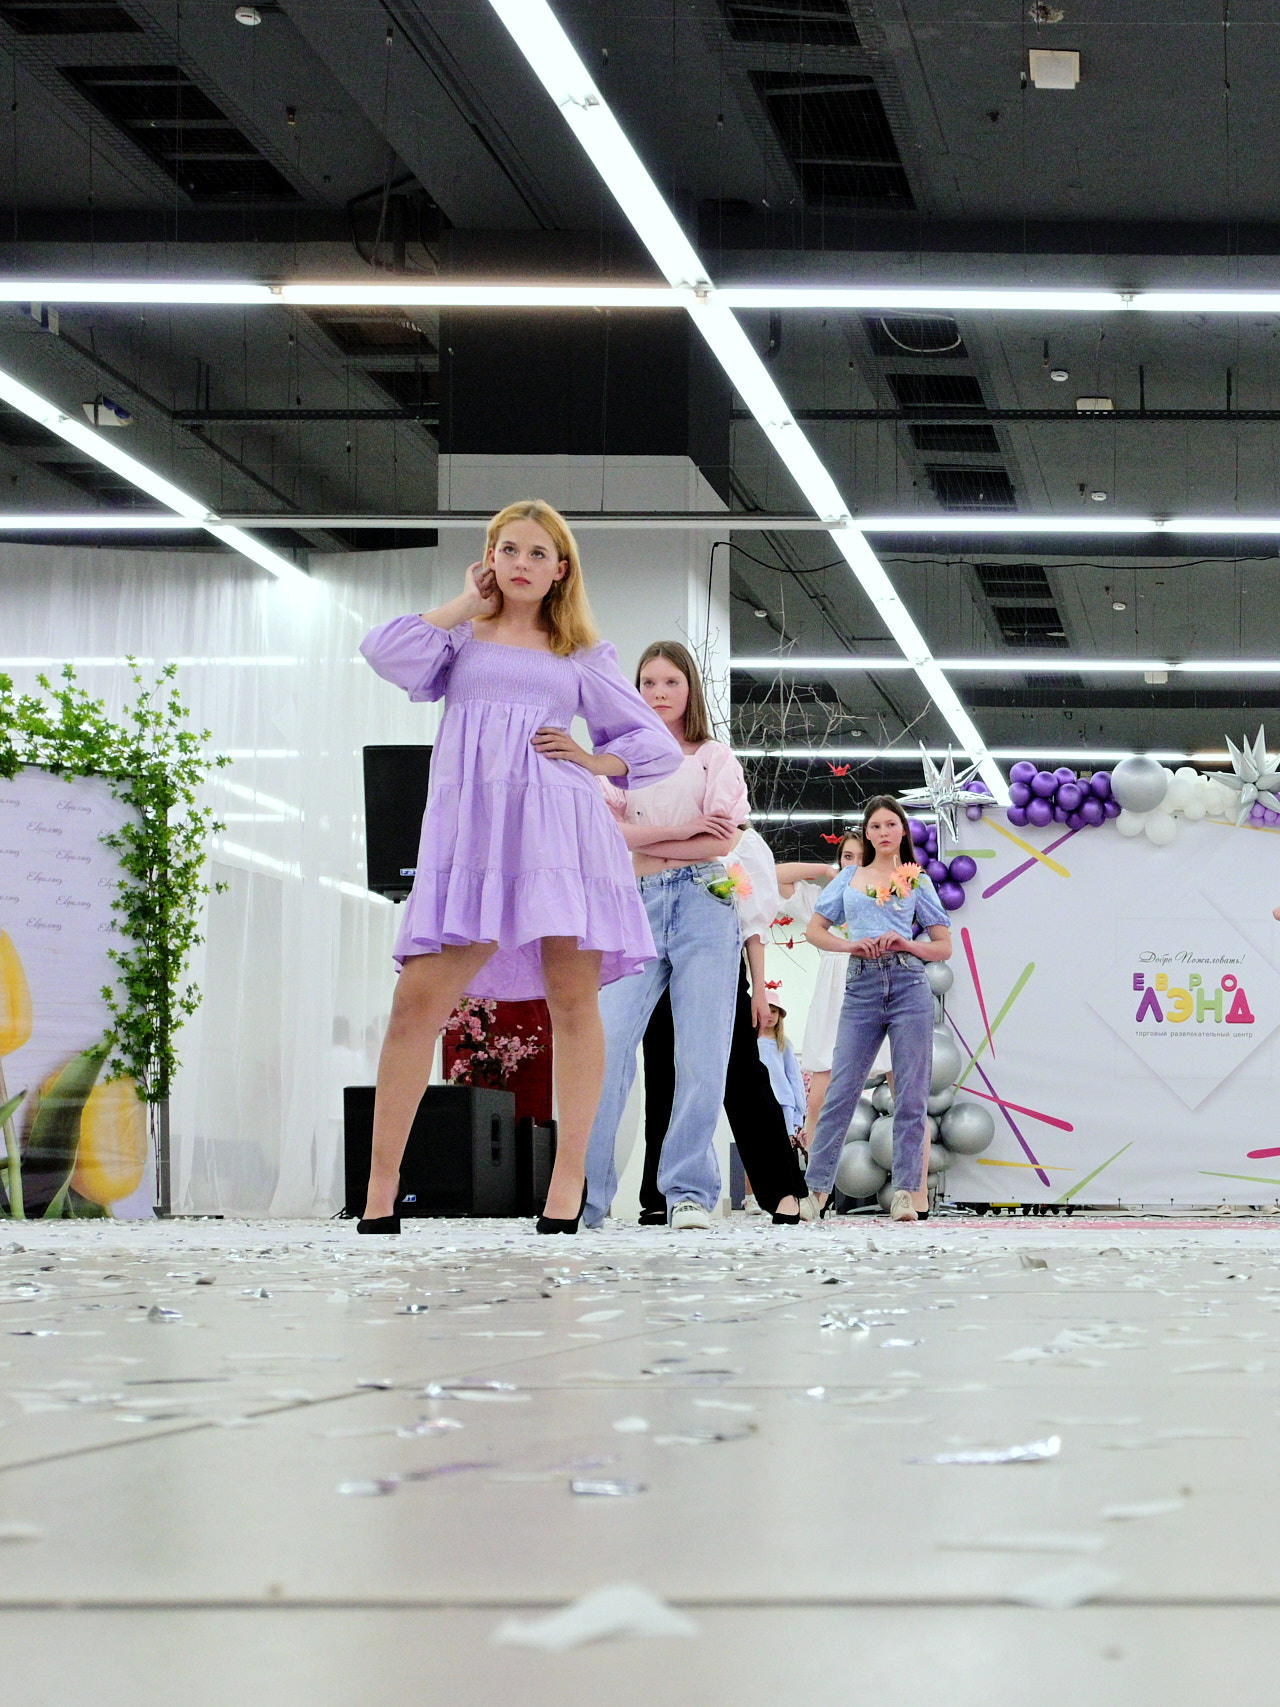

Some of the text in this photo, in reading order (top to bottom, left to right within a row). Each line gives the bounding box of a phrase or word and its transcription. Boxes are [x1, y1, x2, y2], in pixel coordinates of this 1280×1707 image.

[1139, 951, 1246, 966] Добро Пожаловать!
[1133, 973, 1238, 992] ЕВРО
[1135, 986, 1255, 1024] ЛЭНД
